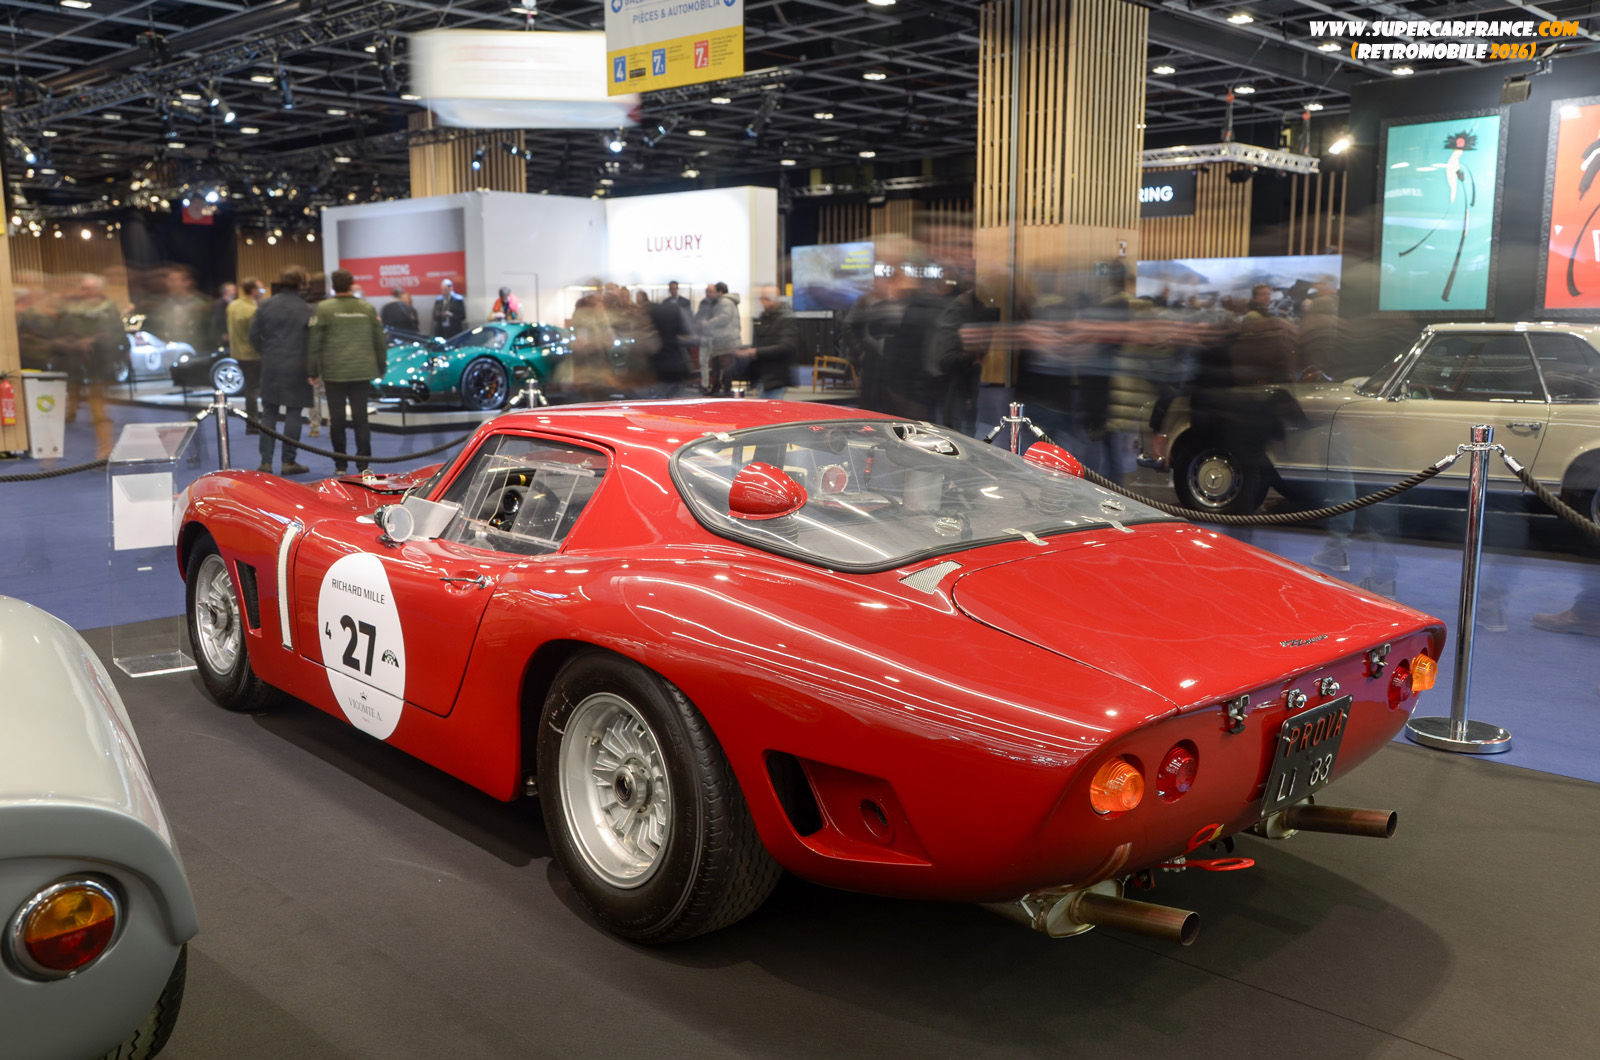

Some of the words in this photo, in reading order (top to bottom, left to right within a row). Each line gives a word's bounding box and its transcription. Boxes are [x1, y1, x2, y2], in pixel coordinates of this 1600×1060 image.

[633, 10, 659, 24] PIÈCES
[661, 9, 666, 18] &
[668, 0, 721, 17] AUTOMOBILIA
[696, 47, 708, 67] 7.2
[616, 62, 625, 79] 4
[647, 234, 702, 252] LUXURY
[331, 578, 362, 597] RICHARD
[363, 588, 385, 605] MILLE
[325, 621, 332, 640] 4
[340, 614, 377, 677] 27
[348, 697, 375, 718] VICOMTE
[1286, 708, 1344, 758] PROVA
[1276, 767, 1297, 802] LI
